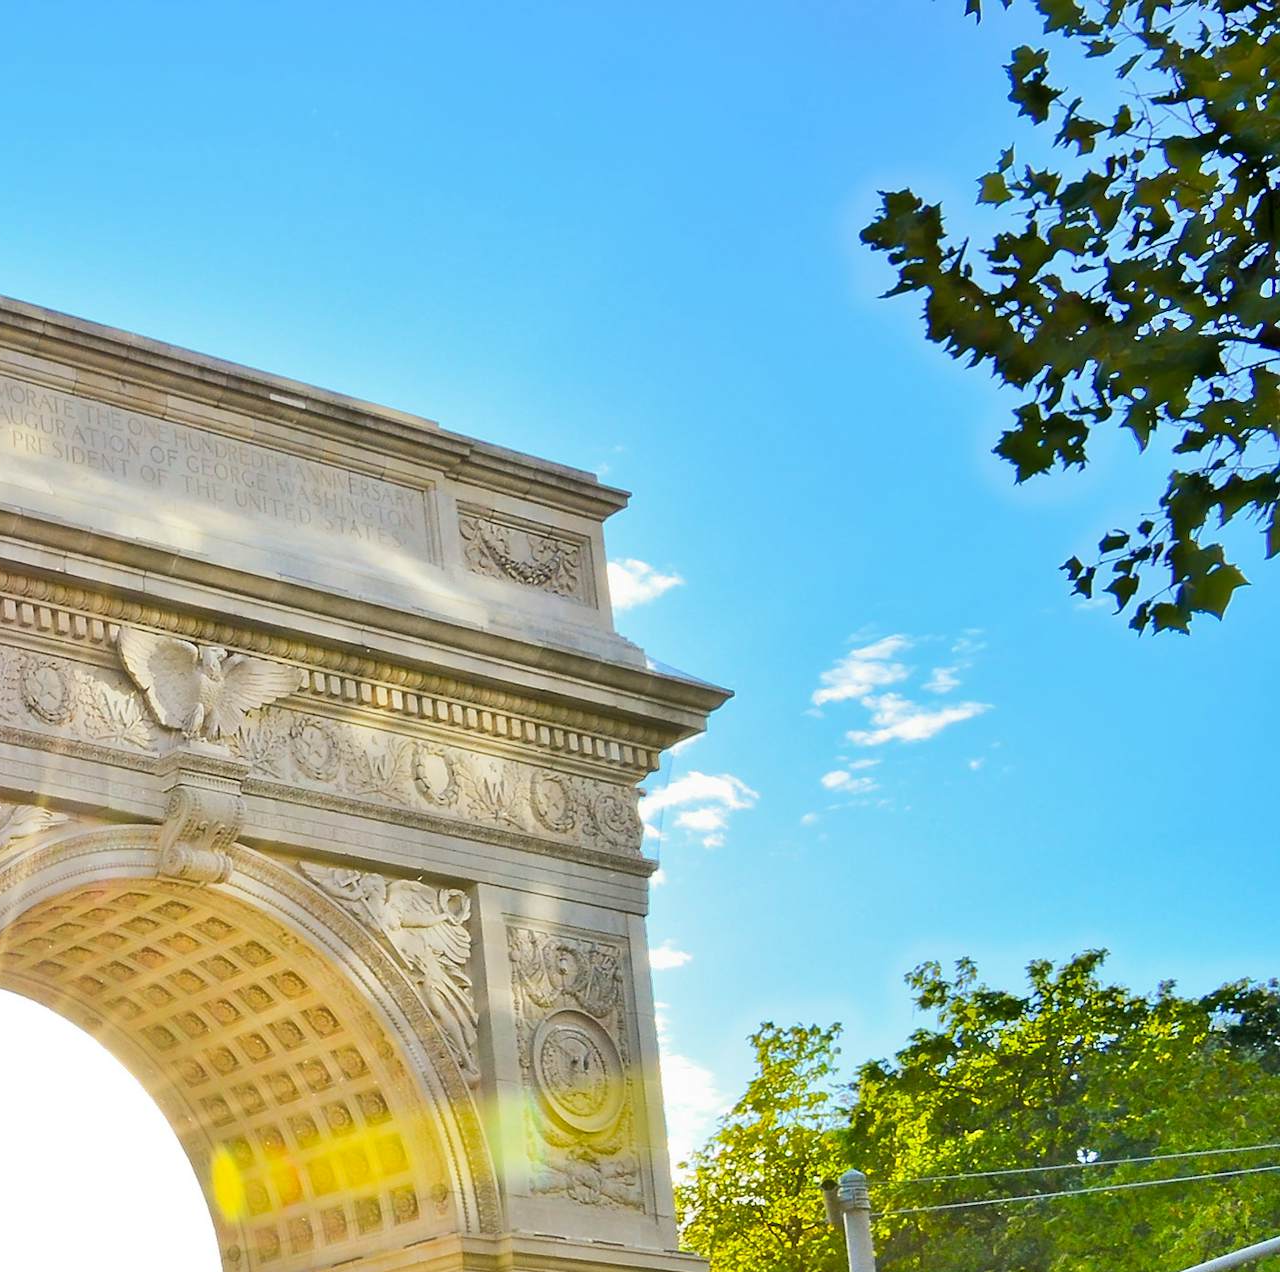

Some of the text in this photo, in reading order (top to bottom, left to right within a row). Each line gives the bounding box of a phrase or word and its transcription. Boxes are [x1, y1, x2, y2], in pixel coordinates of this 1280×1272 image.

[12, 430, 129, 477] PRESIDENT
[140, 464, 168, 487] OF
[181, 474, 225, 502] THE
[234, 488, 312, 526] UNITED
[325, 515, 407, 549] STATES
[82, 404, 123, 432] THE
[127, 417, 168, 444] ONE
[174, 429, 287, 475] HUNDREDTH
[294, 463, 415, 511] ANNIVERSARY
[150, 445, 179, 468] OF
[186, 455, 268, 493] GEORGE
[278, 478, 416, 532] WASHINGTON
